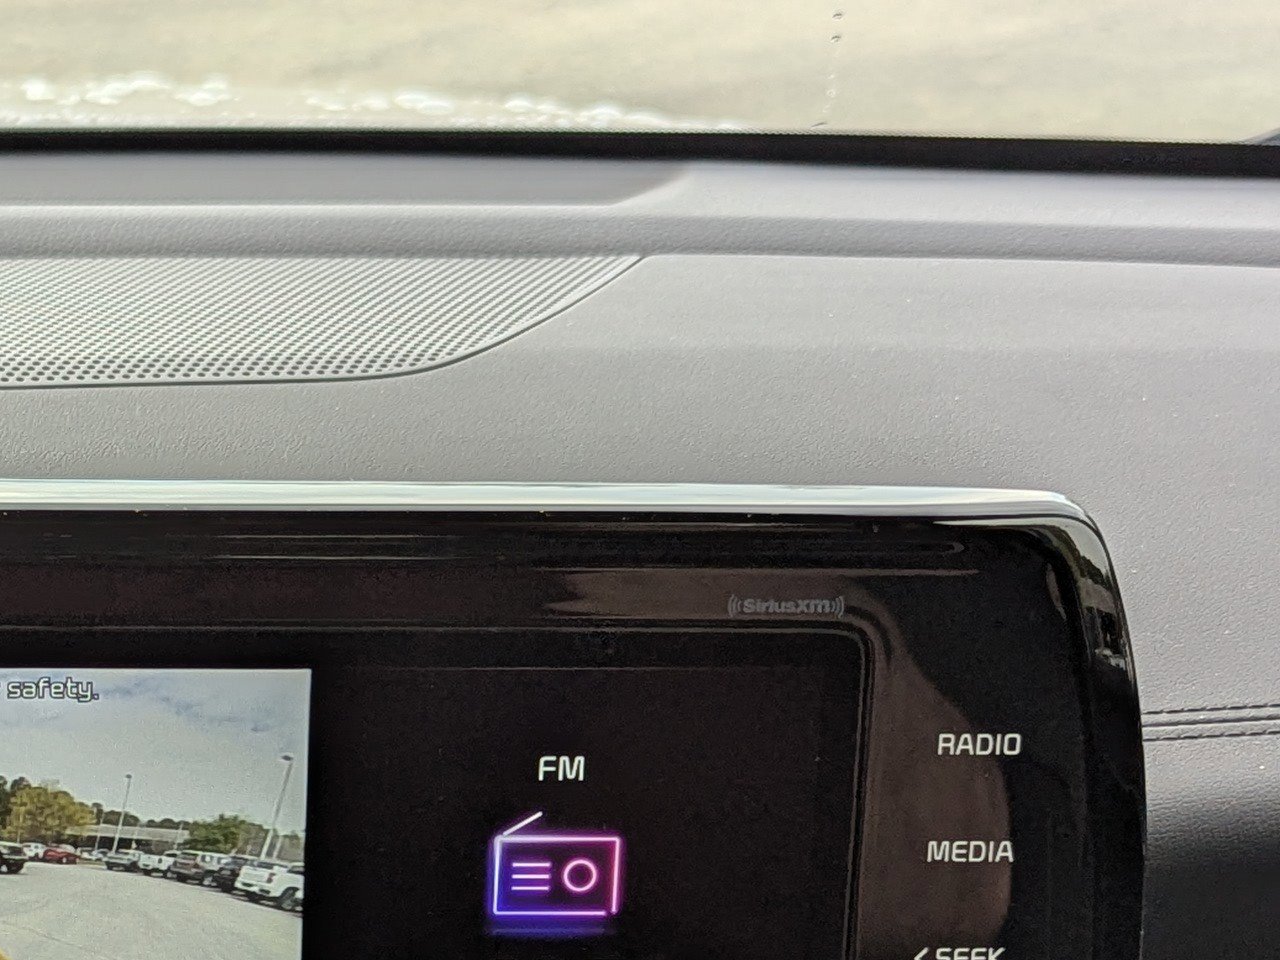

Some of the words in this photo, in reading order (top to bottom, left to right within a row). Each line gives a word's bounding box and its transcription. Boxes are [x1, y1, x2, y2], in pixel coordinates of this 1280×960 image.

[6, 677, 100, 703] safety.
[937, 733, 1022, 757] RADIO
[538, 755, 586, 782] FM
[926, 840, 1015, 864] MEDIA
